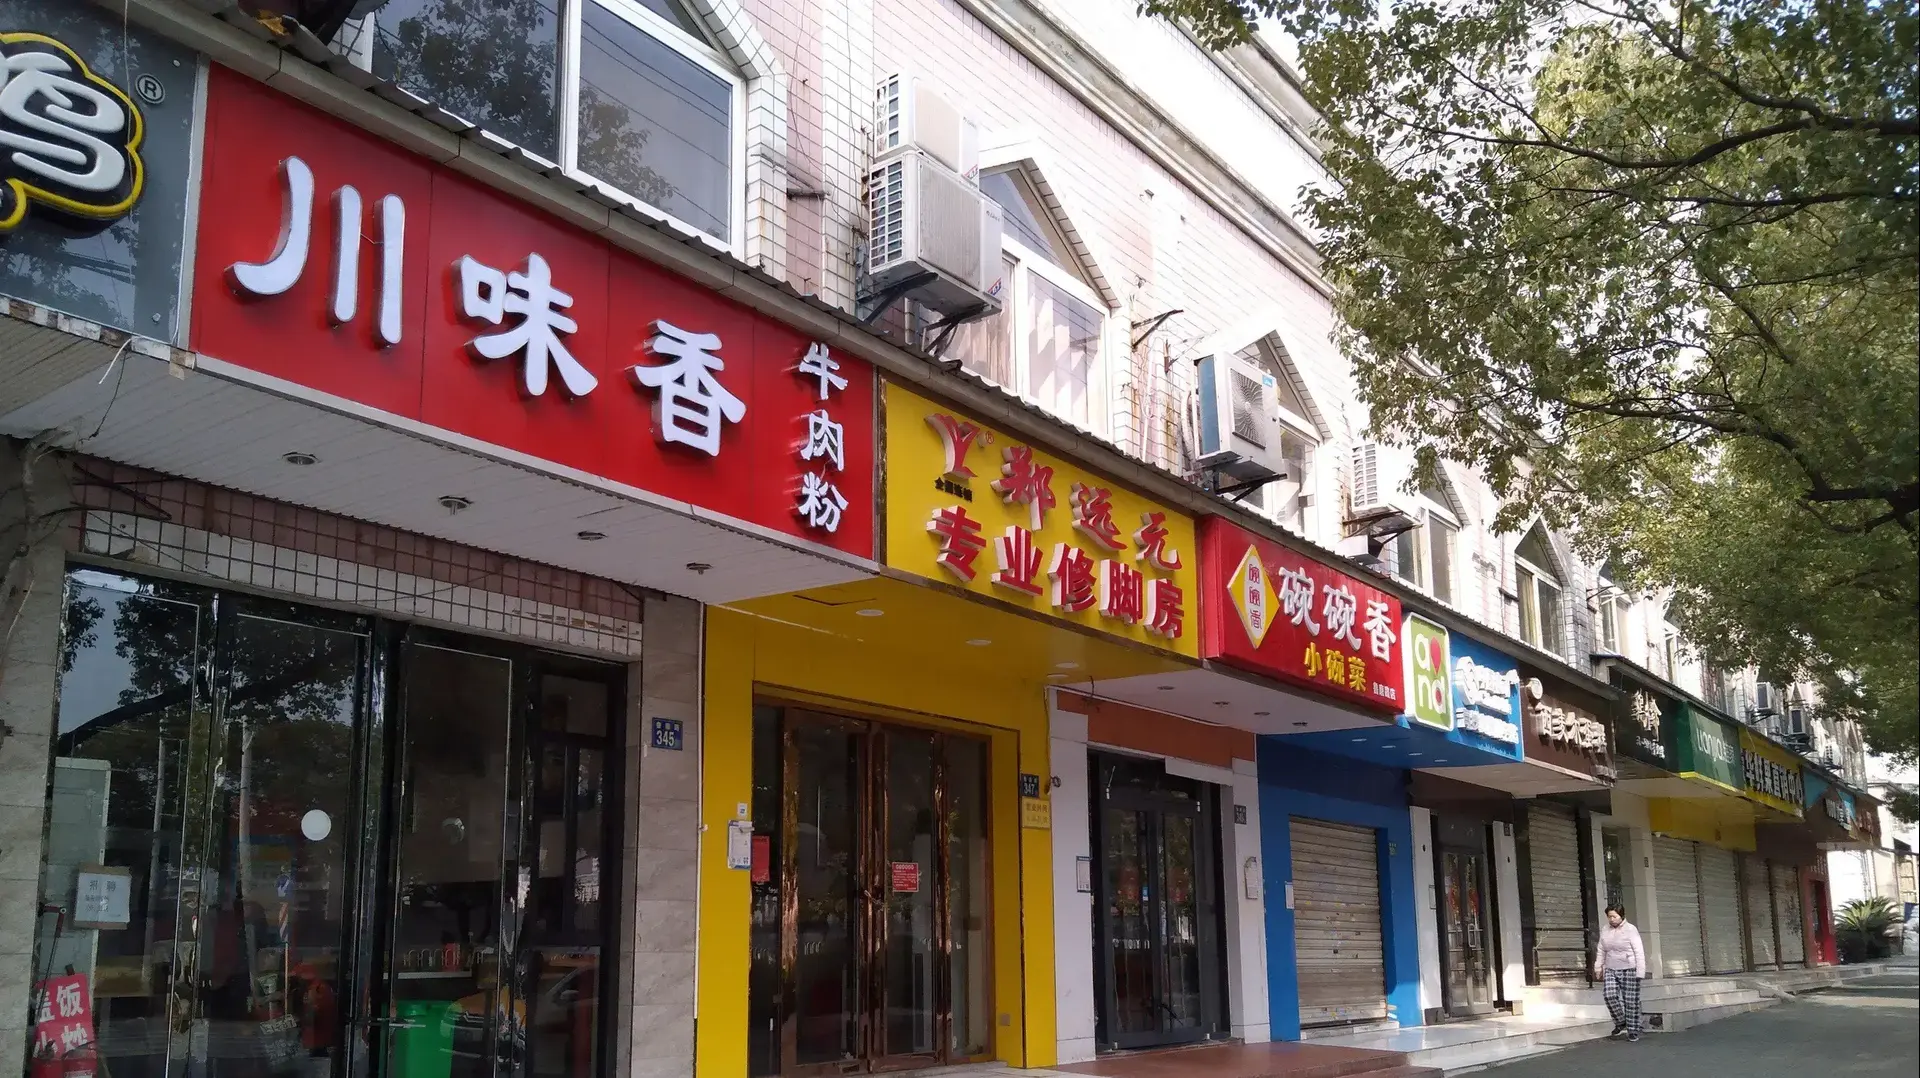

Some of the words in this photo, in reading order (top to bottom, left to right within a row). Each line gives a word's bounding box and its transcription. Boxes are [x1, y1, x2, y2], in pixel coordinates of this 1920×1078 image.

[230, 156, 747, 458] 川味香
[798, 341, 849, 534] 牛肉粉
[991, 446, 1182, 571] 郑远元
[927, 505, 1185, 639] 专业修脚房
[1278, 566, 1396, 663] 碗碗香
[1304, 641, 1367, 692] 小碗菜
[656, 730, 675, 746] 345
[1023, 782, 1035, 795] 347
